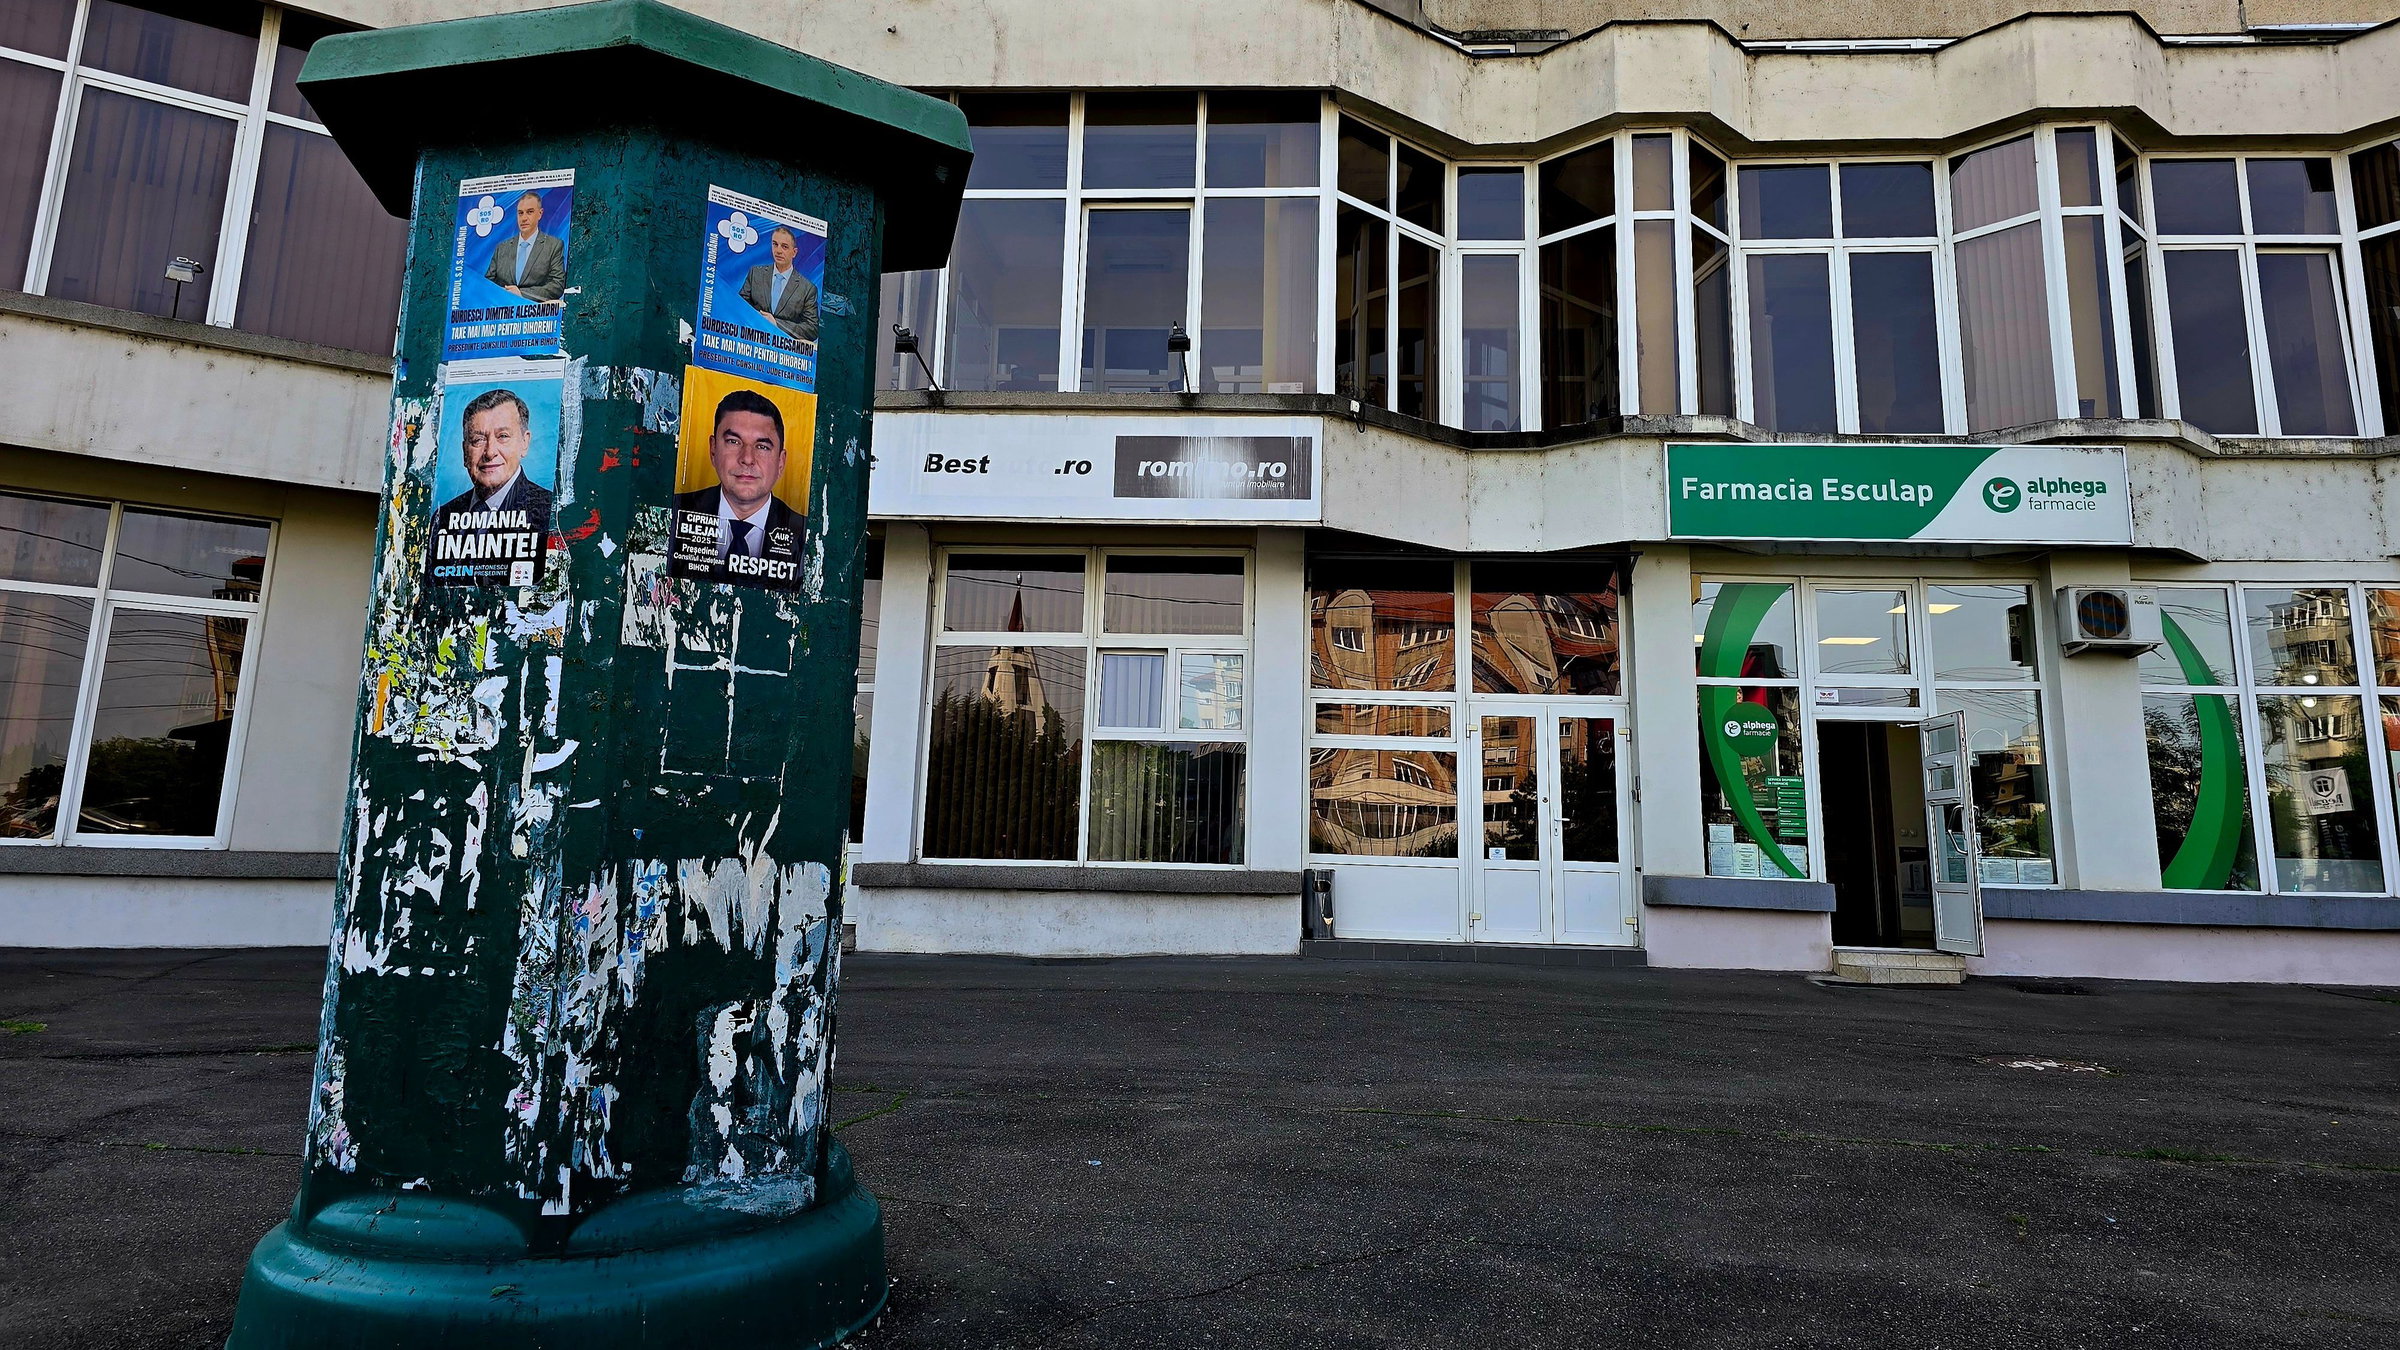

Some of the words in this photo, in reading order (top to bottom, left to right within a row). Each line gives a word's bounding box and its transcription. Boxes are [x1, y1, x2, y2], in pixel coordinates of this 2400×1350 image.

[732, 226, 745, 234] SOS
[707, 232, 719, 264] ROMÂNIA
[452, 279, 462, 310] PARTIDUL
[457, 225, 468, 256] ROMÂNIA
[703, 286, 714, 317] PARTIDUL
[485, 306, 514, 320] DIMITRIE
[516, 303, 559, 318] ALECSANDRU
[452, 327, 467, 340] TAXE
[467, 325, 480, 338] MAI
[481, 324, 496, 337] MICI
[497, 322, 521, 336] PENTRU
[540, 338, 558, 346] BIHOR
[702, 333, 719, 349] TAXE
[721, 339, 735, 353] MAI
[736, 341, 752, 357] MICI
[753, 345, 778, 363] PENTRU
[740, 326, 770, 346] DIMITRIE
[772, 335, 814, 357] ALECSANDRU
[795, 373, 813, 385] BIHOR
[1681, 477, 1813, 502] Farmacia
[1822, 478, 1934, 507] Esculap
[2027, 476, 2107, 497] alphega
[2028, 496, 2096, 512] farmacie
[448, 508, 531, 530] ROMÂNIA,
[686, 513, 720, 527] CIPRIAN
[680, 522, 724, 539] BLEJAN
[774, 532, 790, 541] AUR
[436, 529, 538, 560] ÎNAINTE!
[691, 535, 711, 544] 2025
[434, 565, 474, 577] CRIN
[688, 562, 710, 573] BIHOR
[728, 553, 798, 581] RESPECT
[1743, 720, 1776, 730] alphega
[1743, 729, 1772, 737] farmacie
